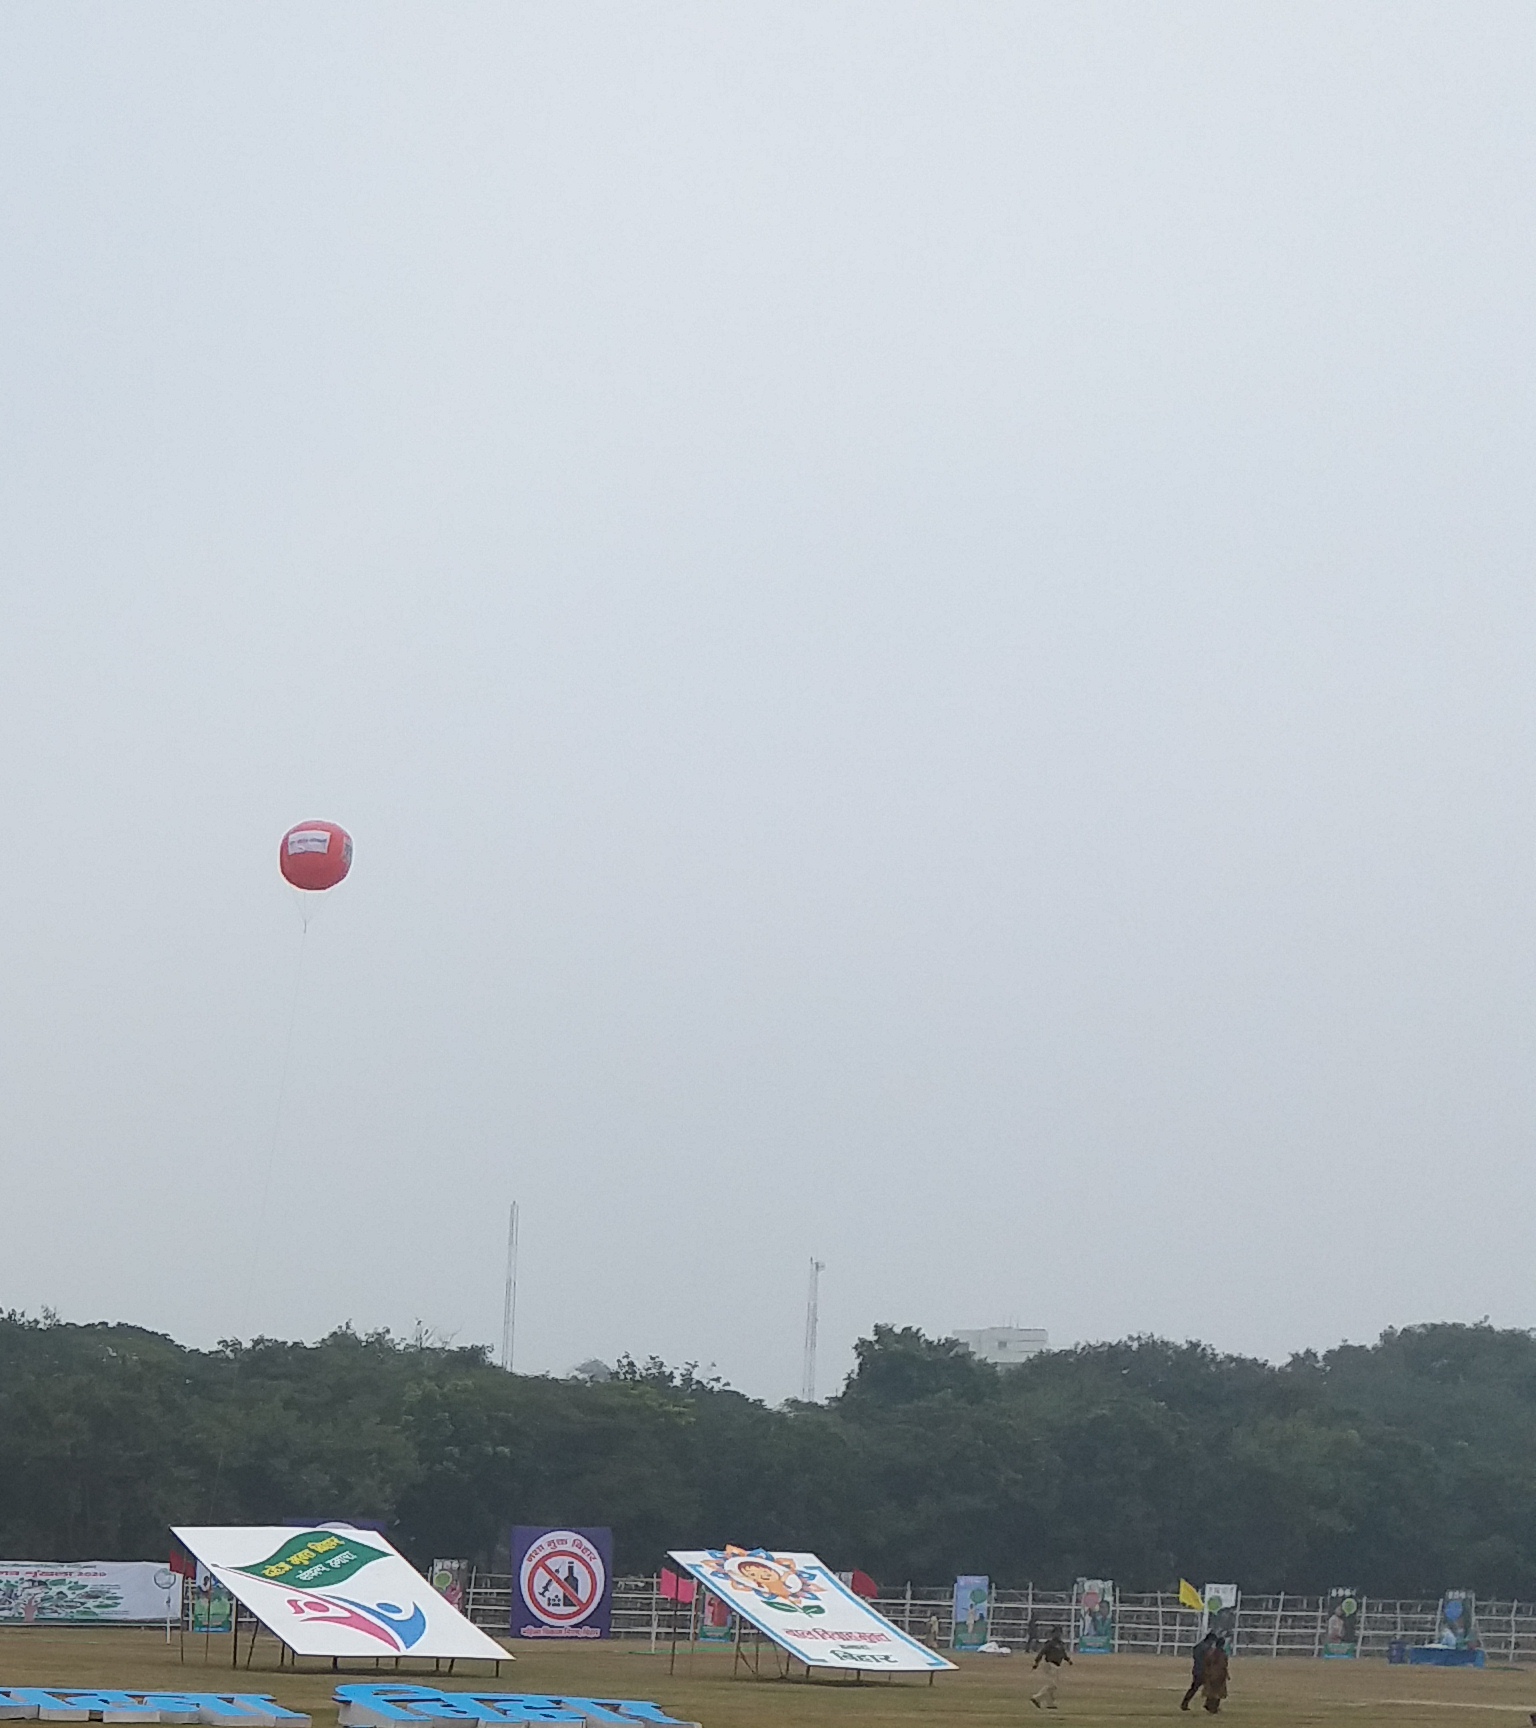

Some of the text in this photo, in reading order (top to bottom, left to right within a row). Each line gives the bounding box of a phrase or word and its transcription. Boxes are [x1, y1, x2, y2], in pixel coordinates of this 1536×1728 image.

[547, 1538, 568, 1550] मुक्त
[571, 1538, 597, 1562] बिहार
[830, 1649, 899, 1663] बिहार
